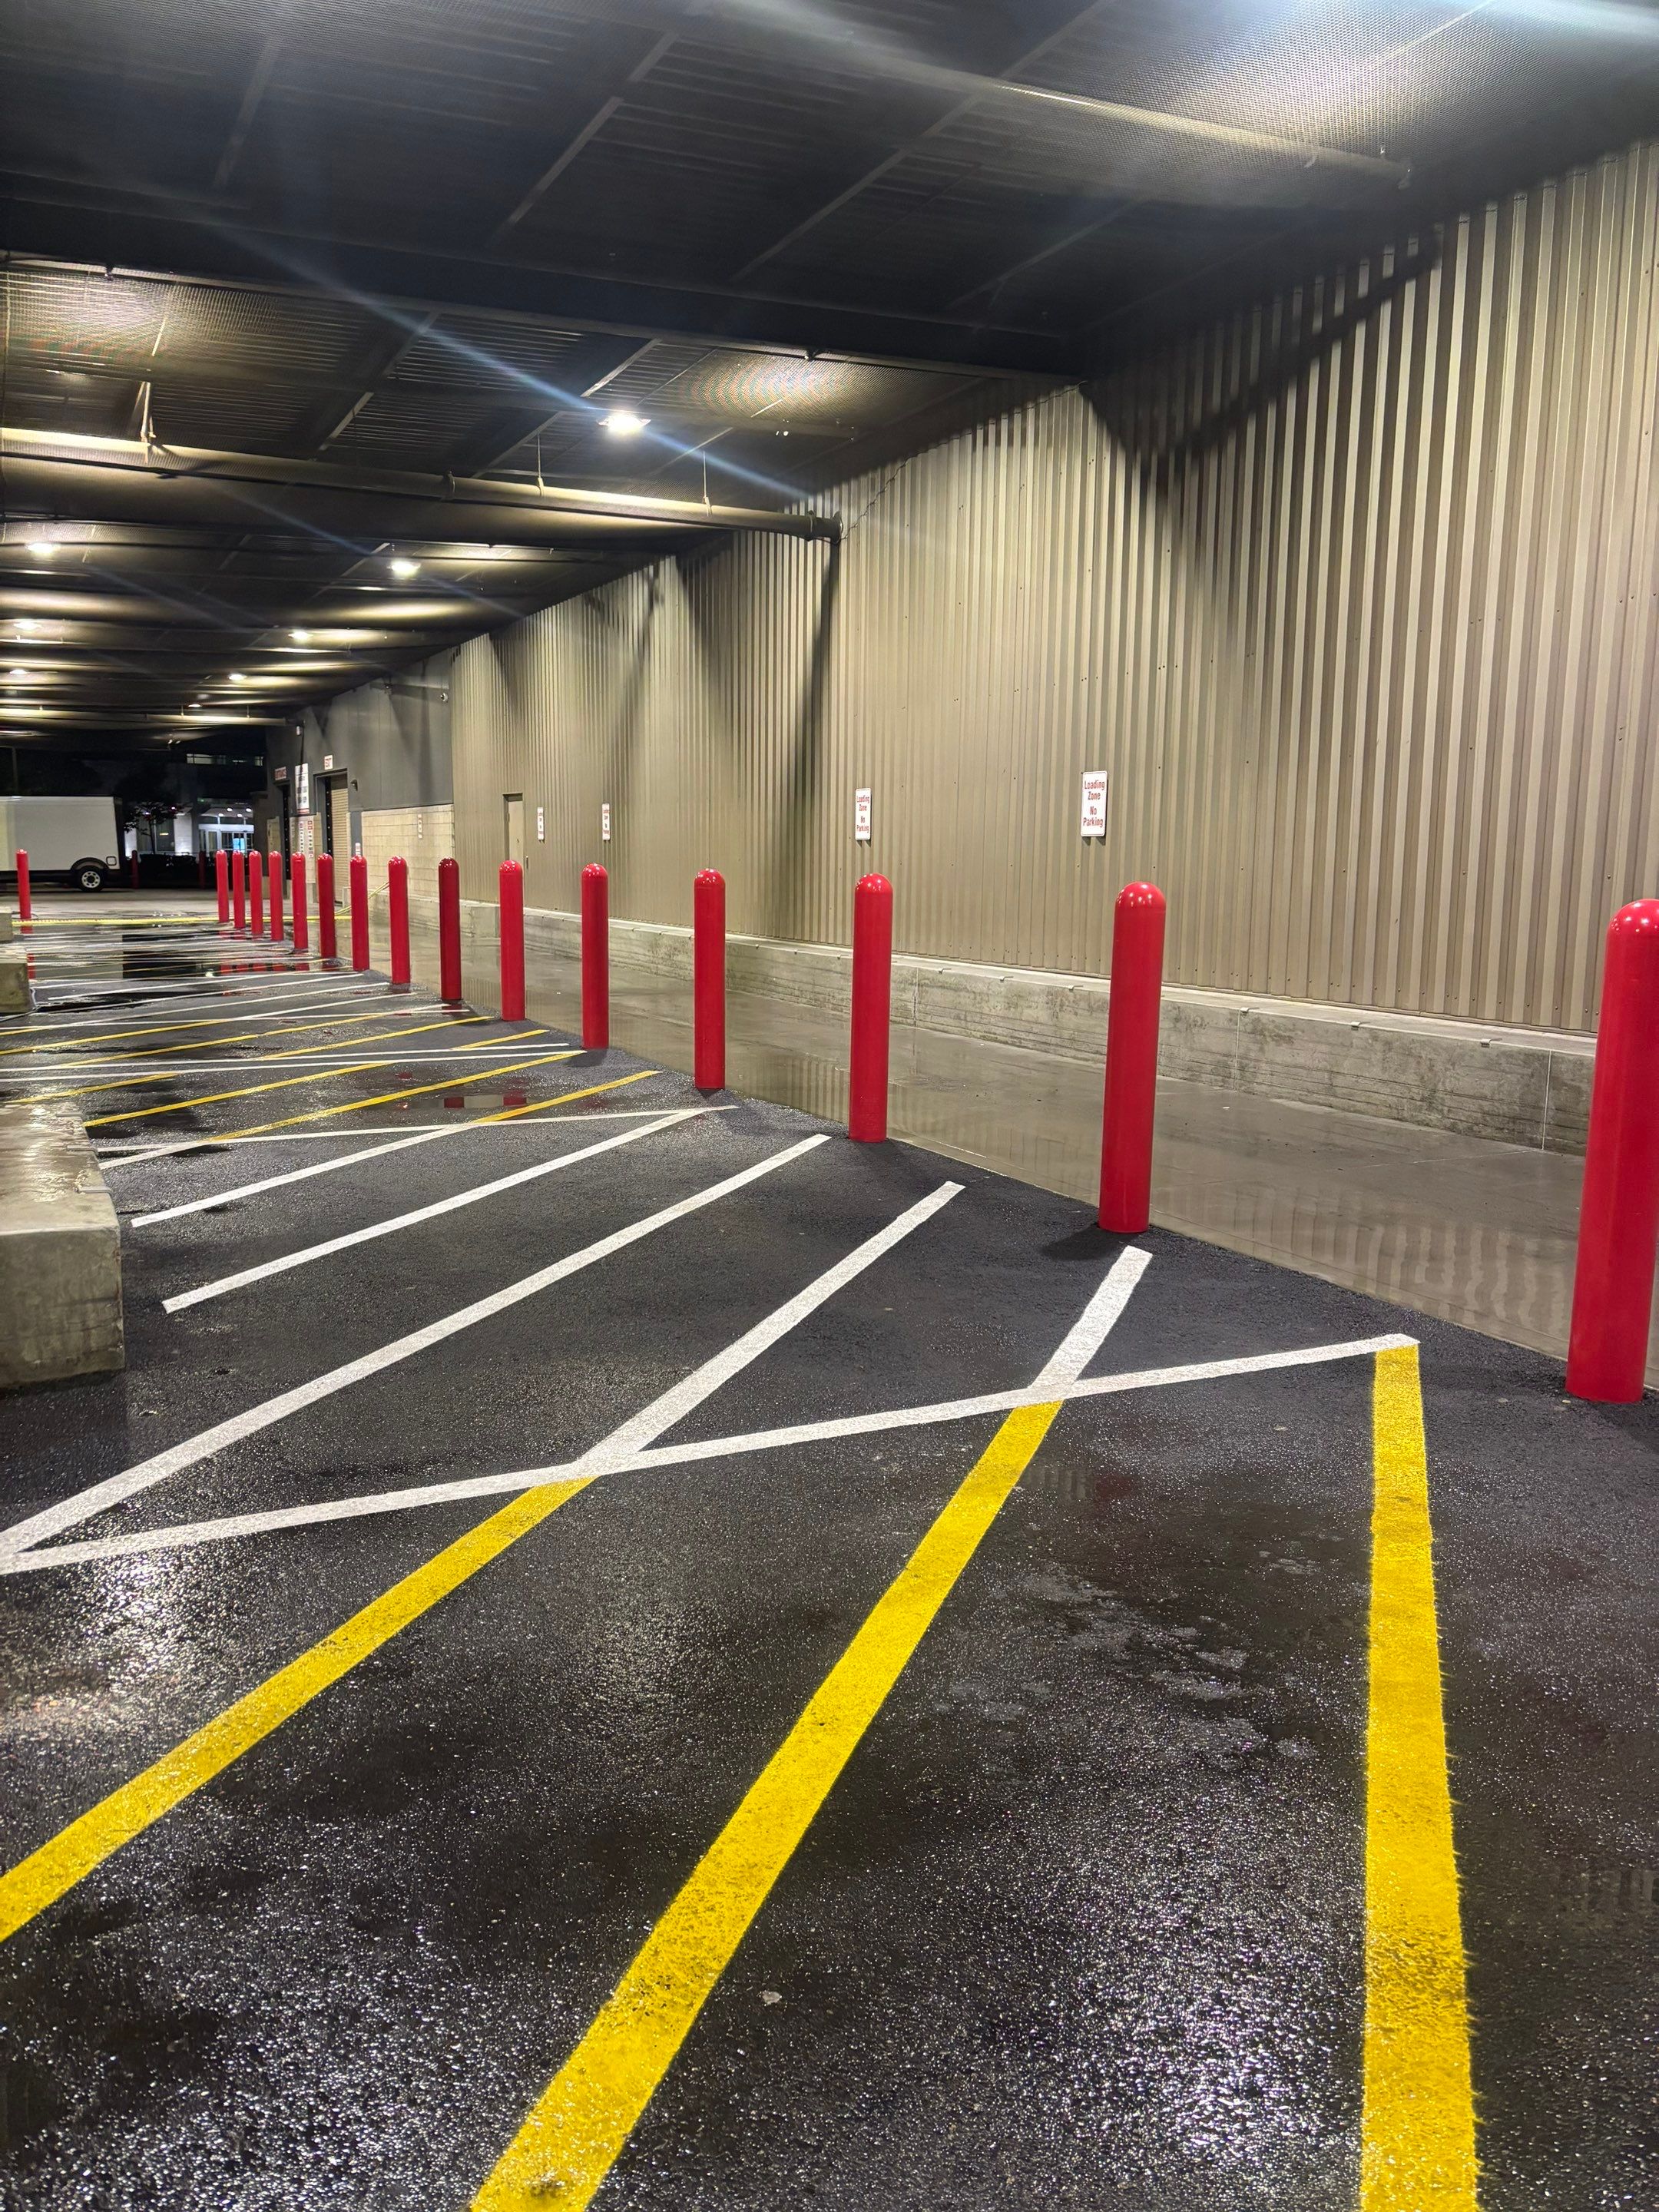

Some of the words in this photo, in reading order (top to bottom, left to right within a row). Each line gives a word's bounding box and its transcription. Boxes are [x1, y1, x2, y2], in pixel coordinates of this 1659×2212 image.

[1084, 780, 1104, 790] Loading
[1088, 791, 1101, 800] Zone
[1090, 806, 1097, 815] No
[1083, 817, 1103, 828] Parking
